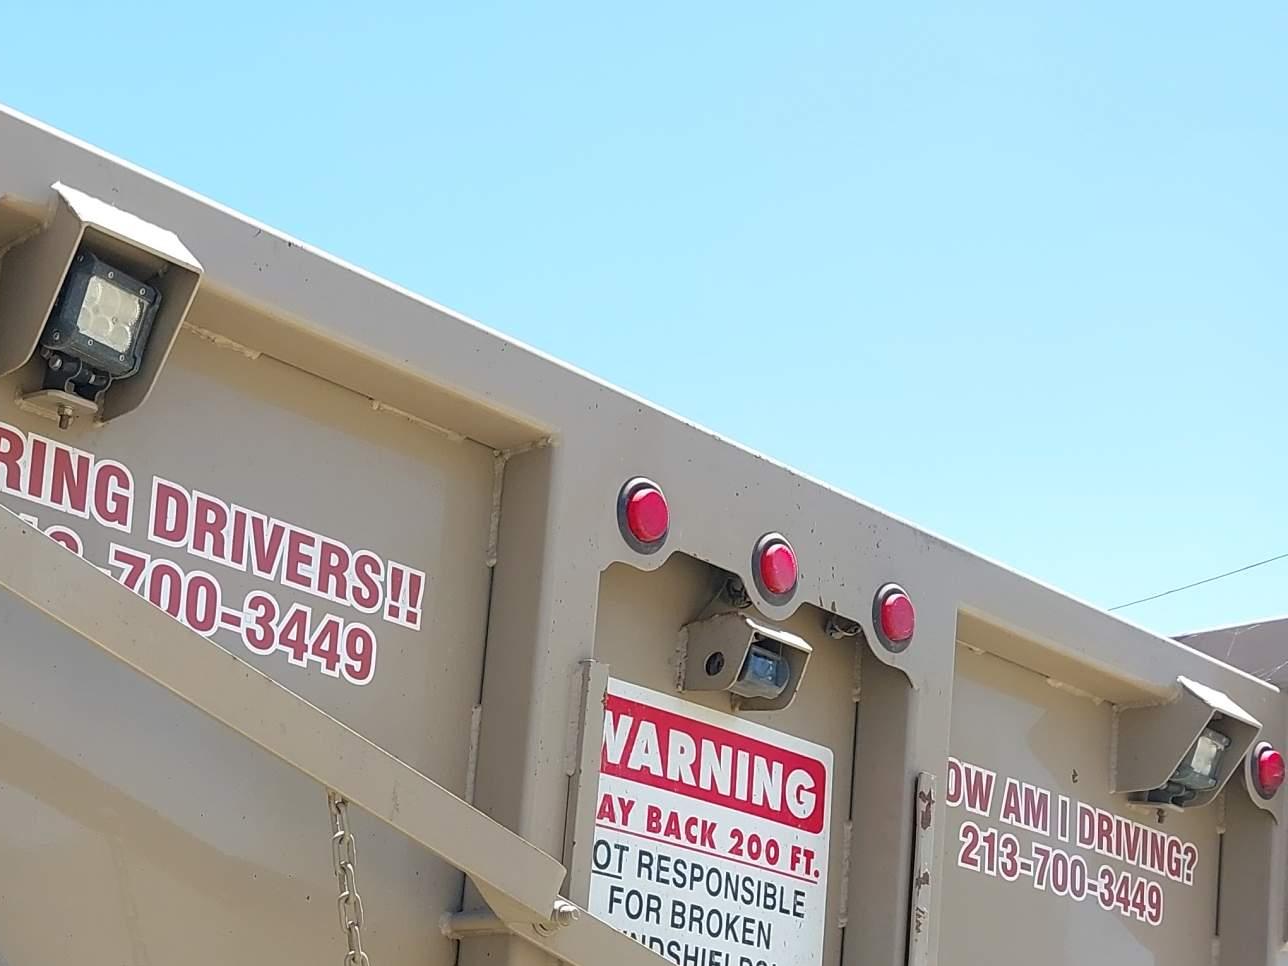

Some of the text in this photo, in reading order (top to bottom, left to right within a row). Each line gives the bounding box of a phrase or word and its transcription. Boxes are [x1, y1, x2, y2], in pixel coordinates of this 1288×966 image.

[151, 480, 424, 627] DRIVERS!!
[597, 793, 820, 879] AY BACK 200 FT.
[946, 758, 1197, 884] OW AM I DRIVING?
[593, 839, 806, 919] OT RESPONSIBLE
[608, 885, 772, 951] FOR BROKEN
[959, 821, 1164, 925] 213-700-3449
